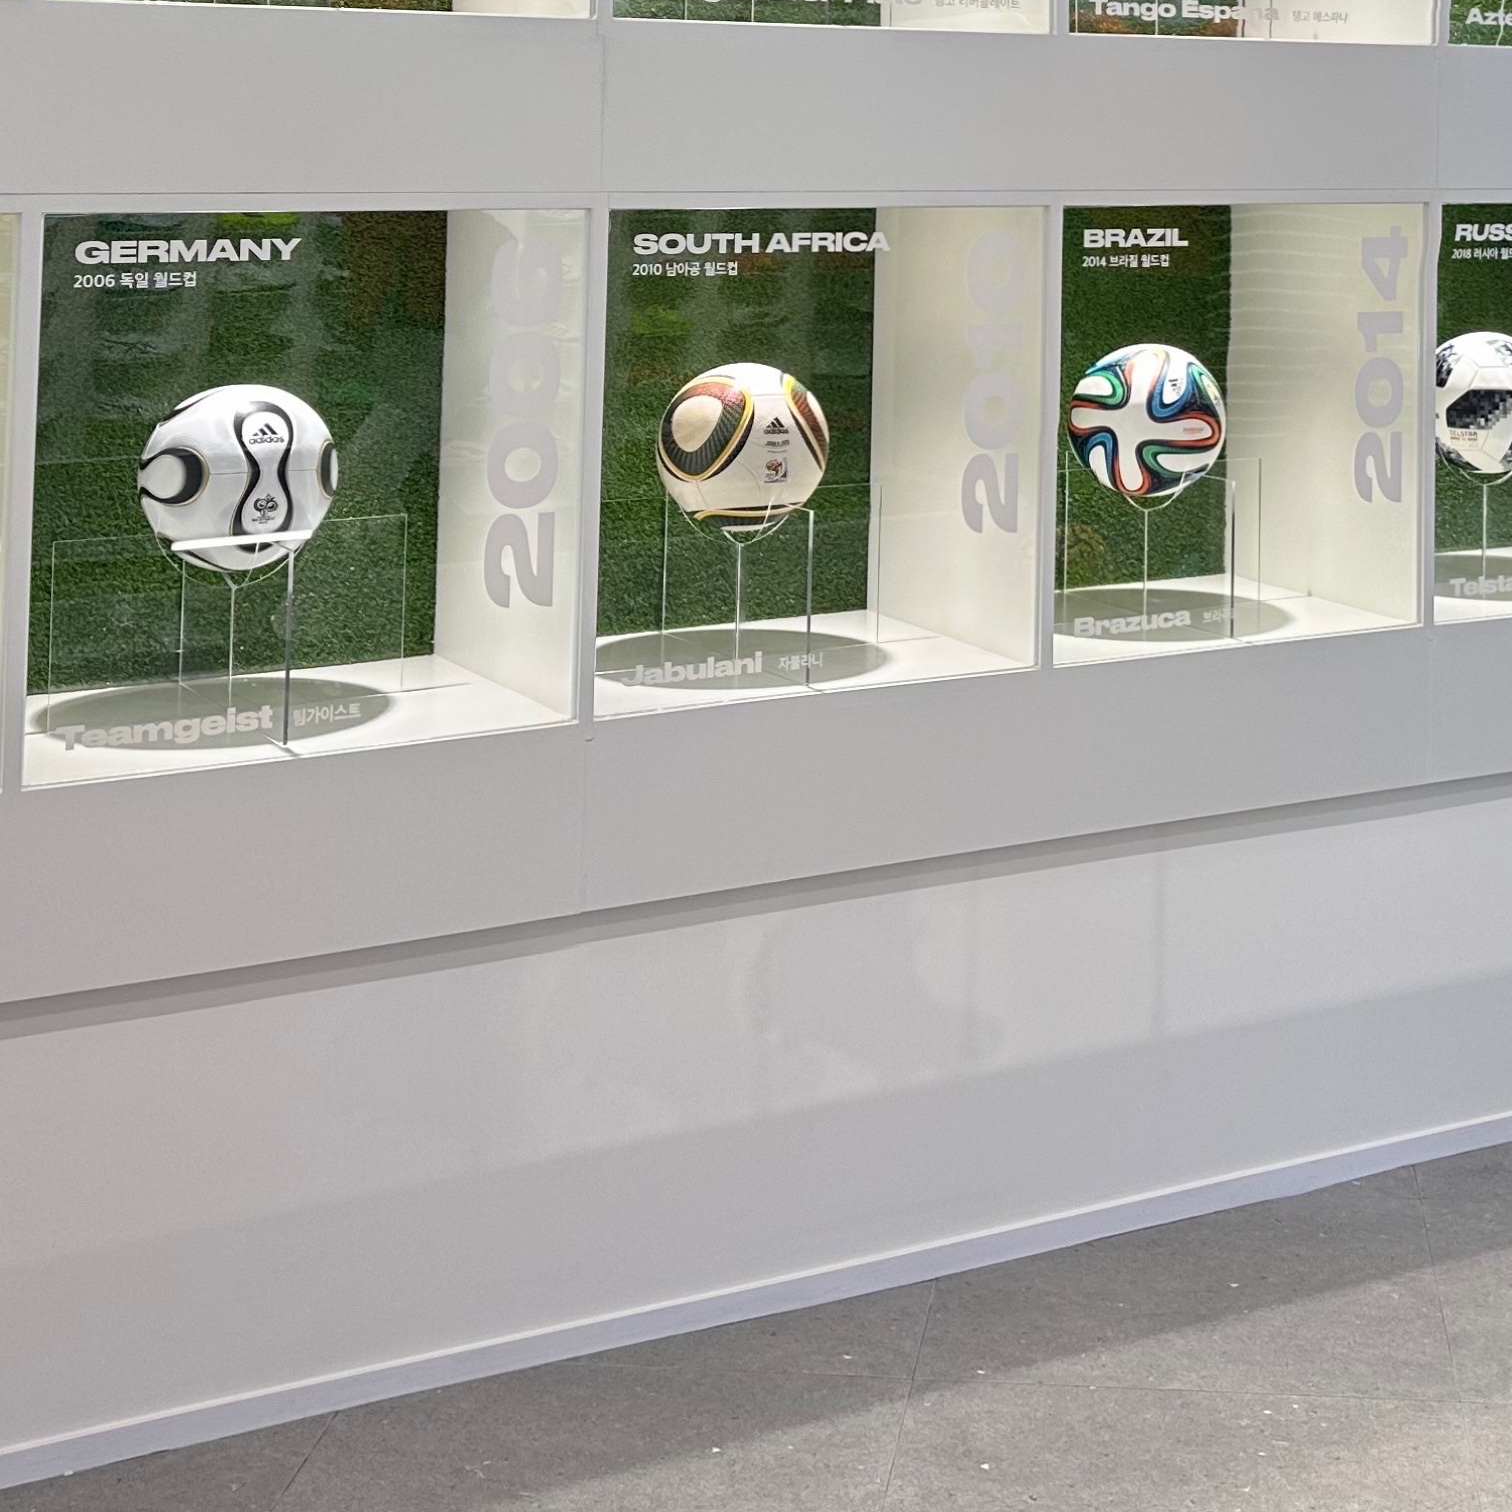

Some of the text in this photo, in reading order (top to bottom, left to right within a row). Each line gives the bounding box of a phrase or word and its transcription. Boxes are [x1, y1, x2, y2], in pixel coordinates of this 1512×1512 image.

[633, 231, 891, 255] SOUTH AFRICA
[1083, 228, 1189, 248] BRAZIL
[74, 238, 302, 265] GERMANY
[1082, 253, 1169, 268] 2014 브라질 월드컵
[1451, 249, 1472, 259] 2018
[1473, 247, 1498, 260] 러시아
[73, 271, 197, 288] 2006 독일 월드컵
[632, 261, 738, 277] 2010 남아공 월드컵
[1354, 225, 1408, 504] 2014
[961, 229, 1026, 535] 2010
[483, 238, 562, 610] 2006
[249, 436, 285, 445] adidas
[1074, 610, 1191, 637] Brazuca
[621, 651, 823, 687] Jabulani 자불라니
[55, 703, 362, 751] Teamgeist 팀가이스트
